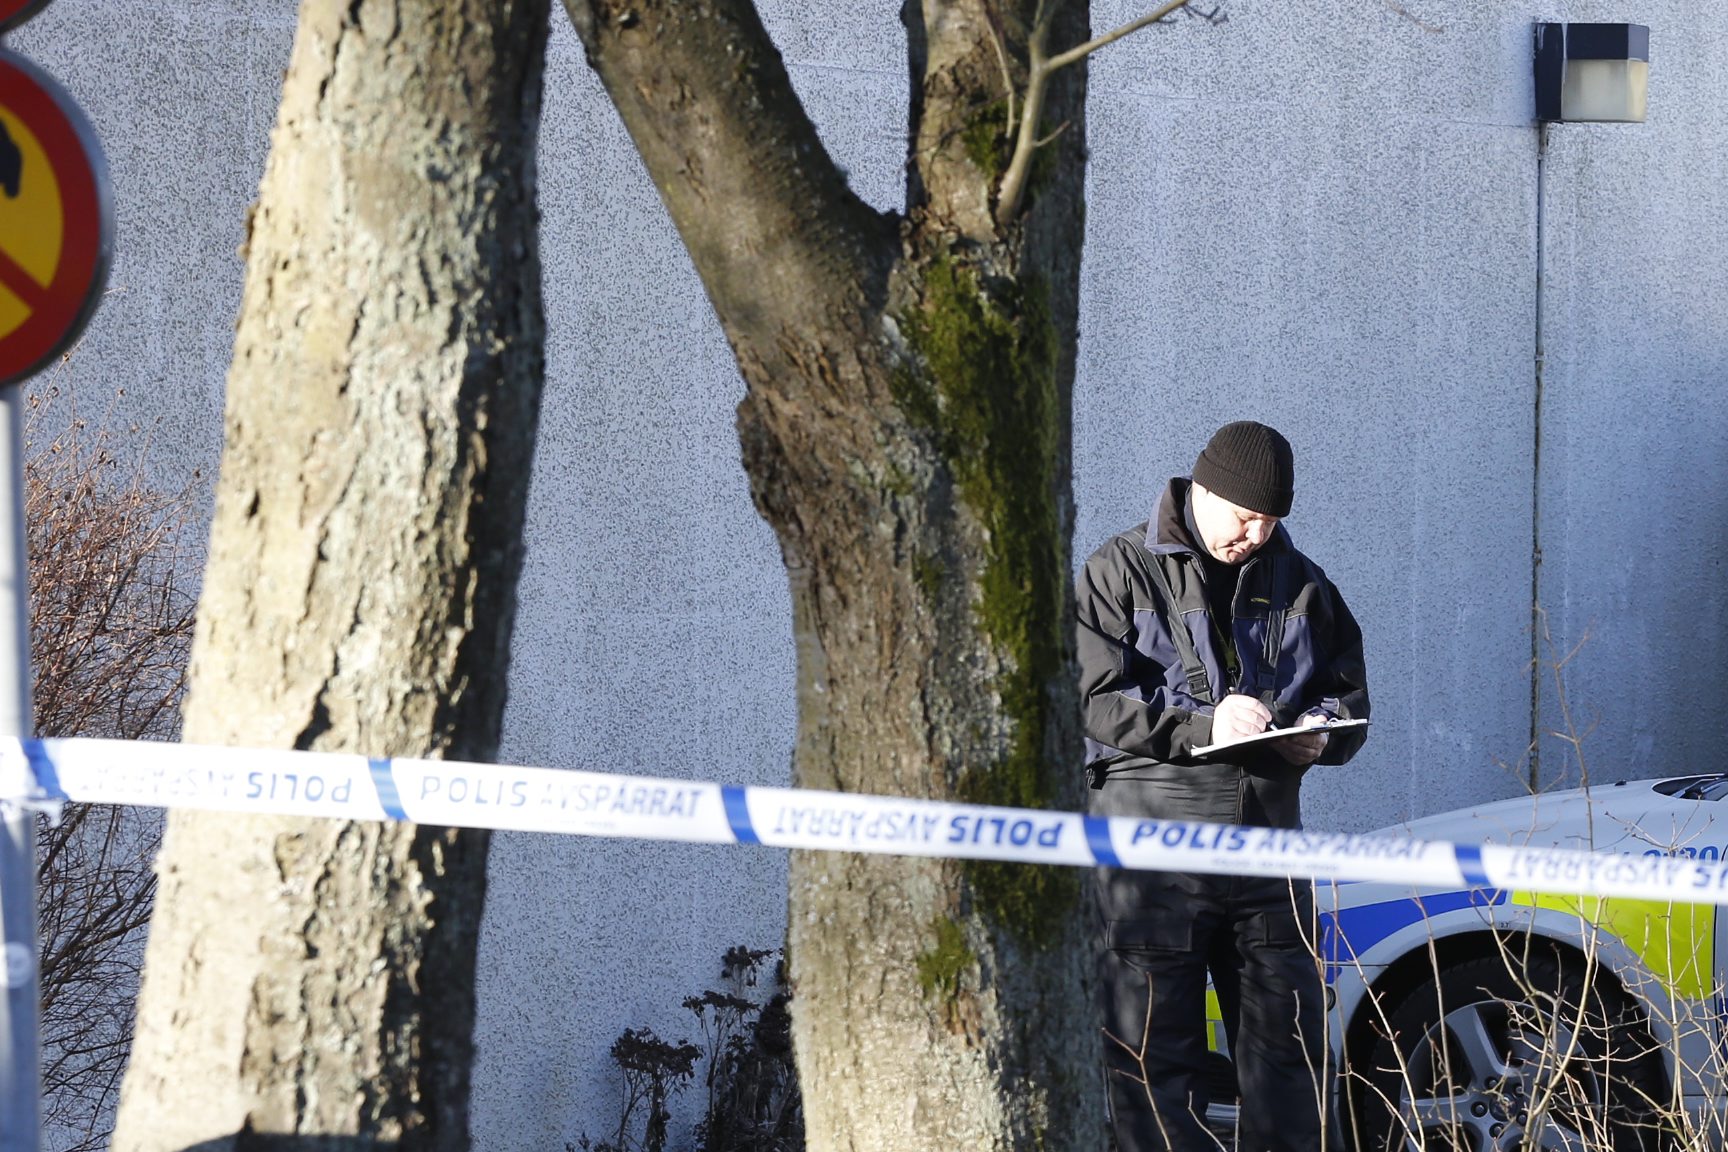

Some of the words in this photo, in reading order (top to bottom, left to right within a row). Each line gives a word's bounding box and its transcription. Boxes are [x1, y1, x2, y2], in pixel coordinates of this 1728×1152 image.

[246, 770, 352, 803] POLIS
[420, 776, 529, 807] POLIS
[949, 815, 1063, 848] POLIS
[1131, 820, 1250, 852] POLIS
